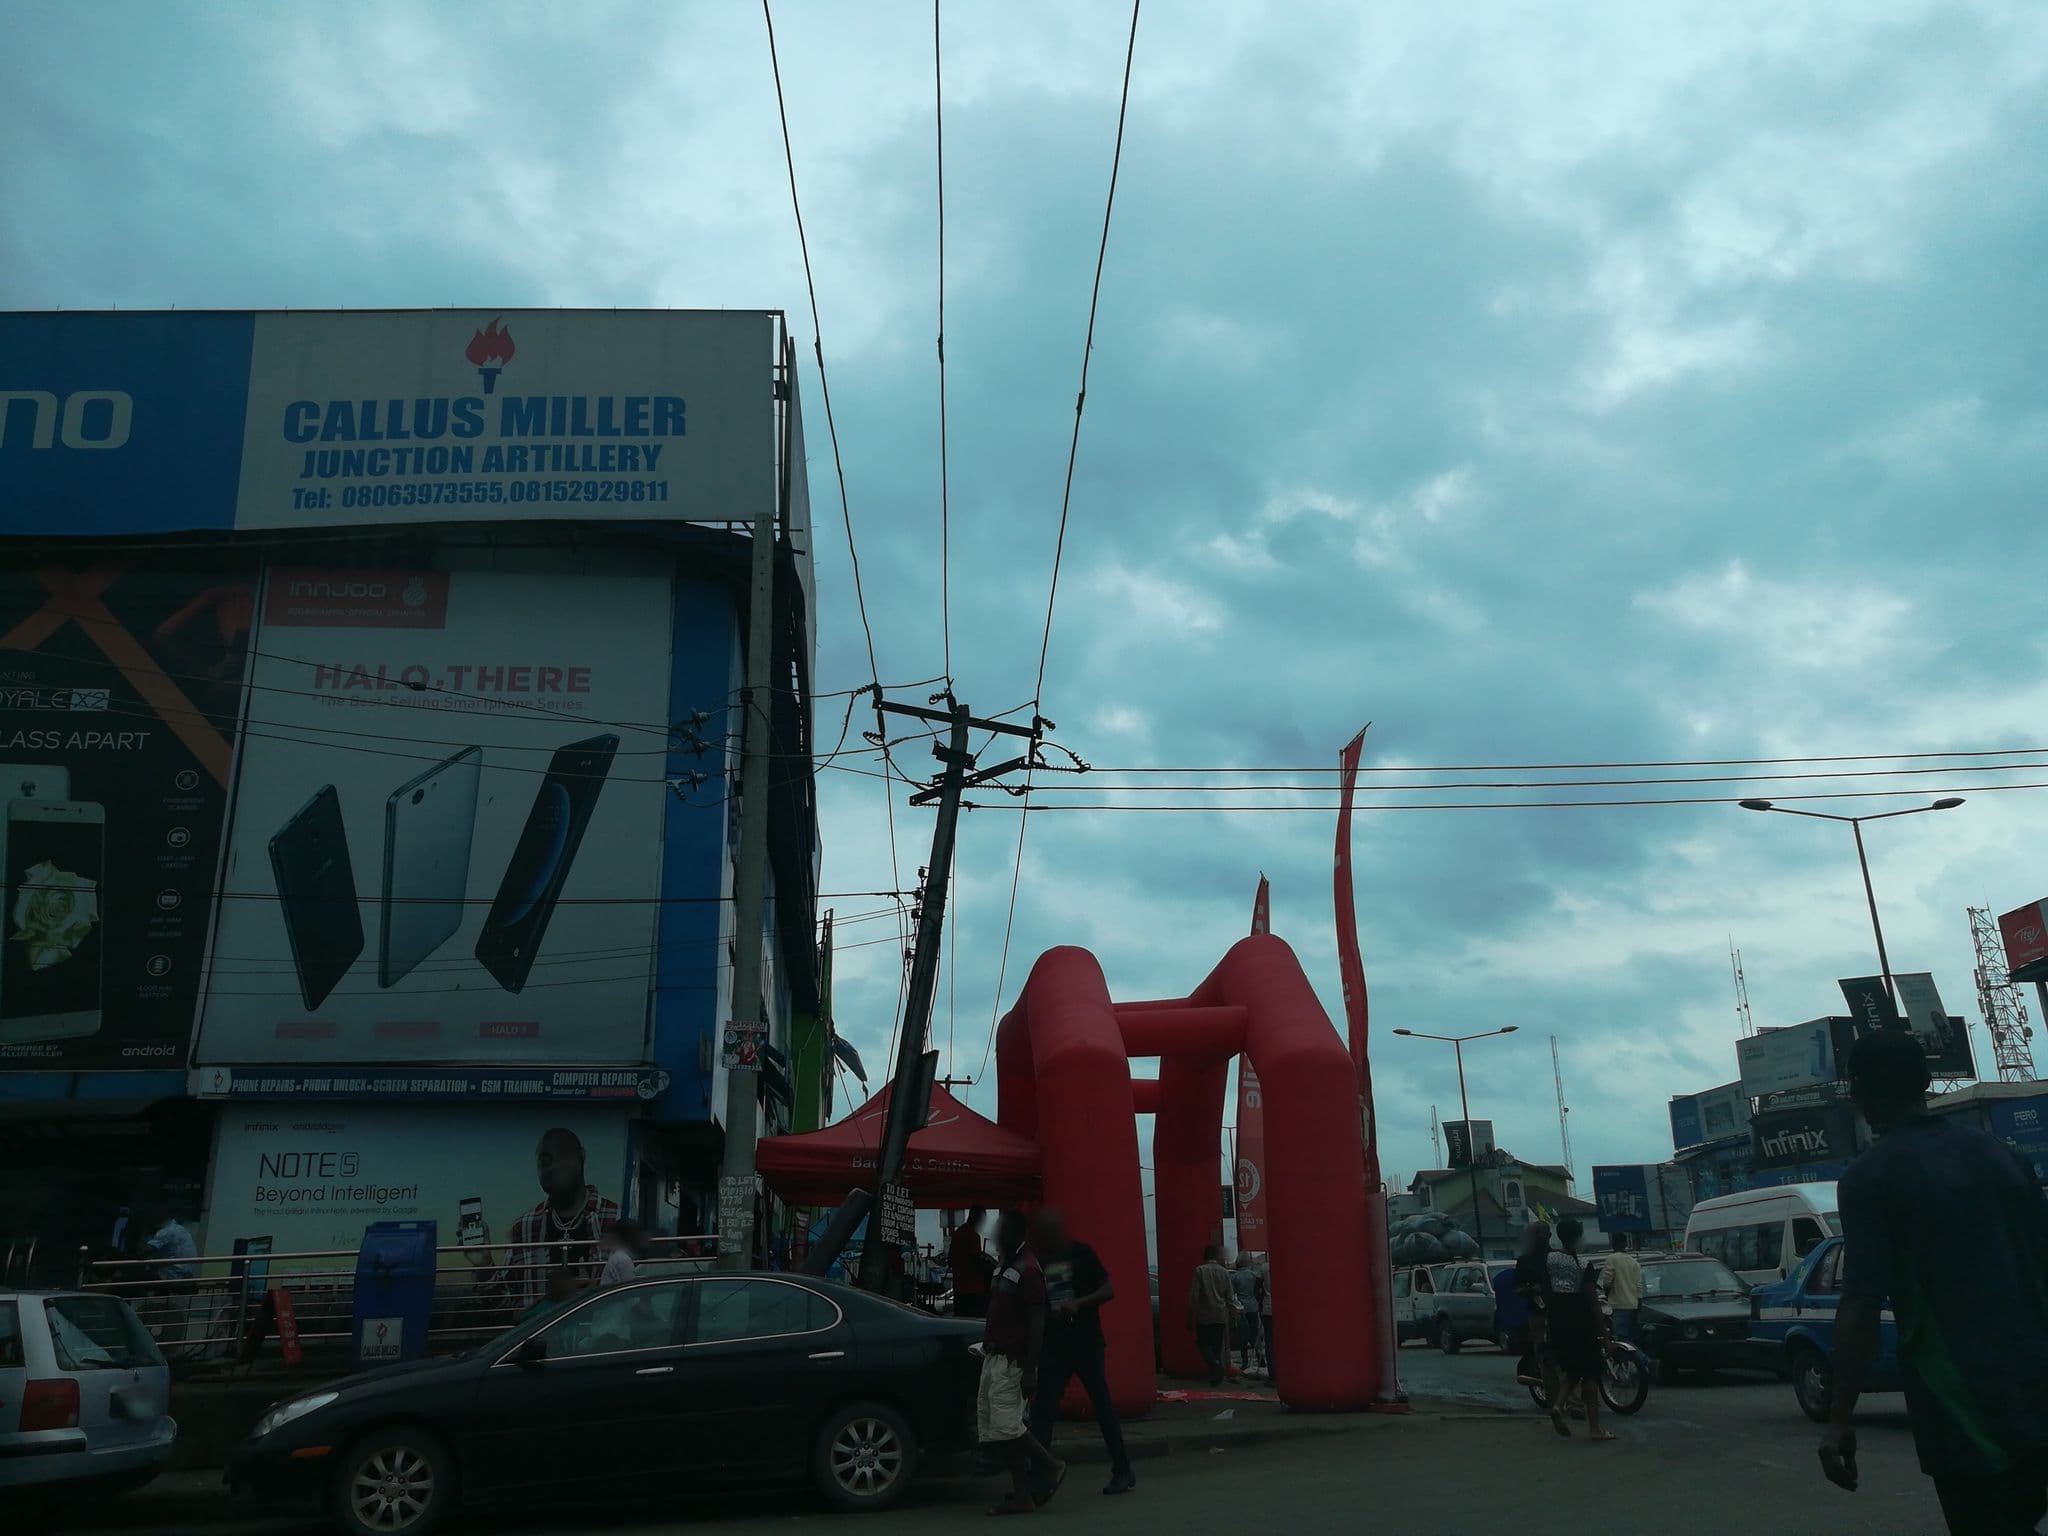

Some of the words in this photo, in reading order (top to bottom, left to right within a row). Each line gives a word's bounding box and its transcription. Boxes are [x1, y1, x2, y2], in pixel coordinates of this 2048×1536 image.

[283, 398, 486, 443] CALLUS
[499, 396, 687, 437] MILLER
[301, 446, 473, 478] JUNCTION
[482, 444, 663, 472] ARTILLERY
[292, 486, 332, 510] Tel:
[65, 731, 150, 750] APART
[122, 1045, 175, 1056] android
[232, 1079, 259, 1092] PHONE
[261, 1079, 295, 1092] REPAIRS
[302, 1079, 331, 1092] PHONE
[333, 1078, 366, 1092] UNLOCK
[373, 1079, 408, 1092] SCREEN
[410, 1079, 468, 1093] SEPARATION
[481, 1079, 501, 1093] GSM
[504, 1079, 544, 1093] TRAINING
[552, 1072, 600, 1086] COMPUTER
[601, 1072, 638, 1086] REPAIRS
[1761, 1125, 1829, 1158] Infinix
[255, 1185, 326, 1205] Beyond
[331, 1184, 418, 1204] Intelligent
[897, 1186, 910, 1198] LET
